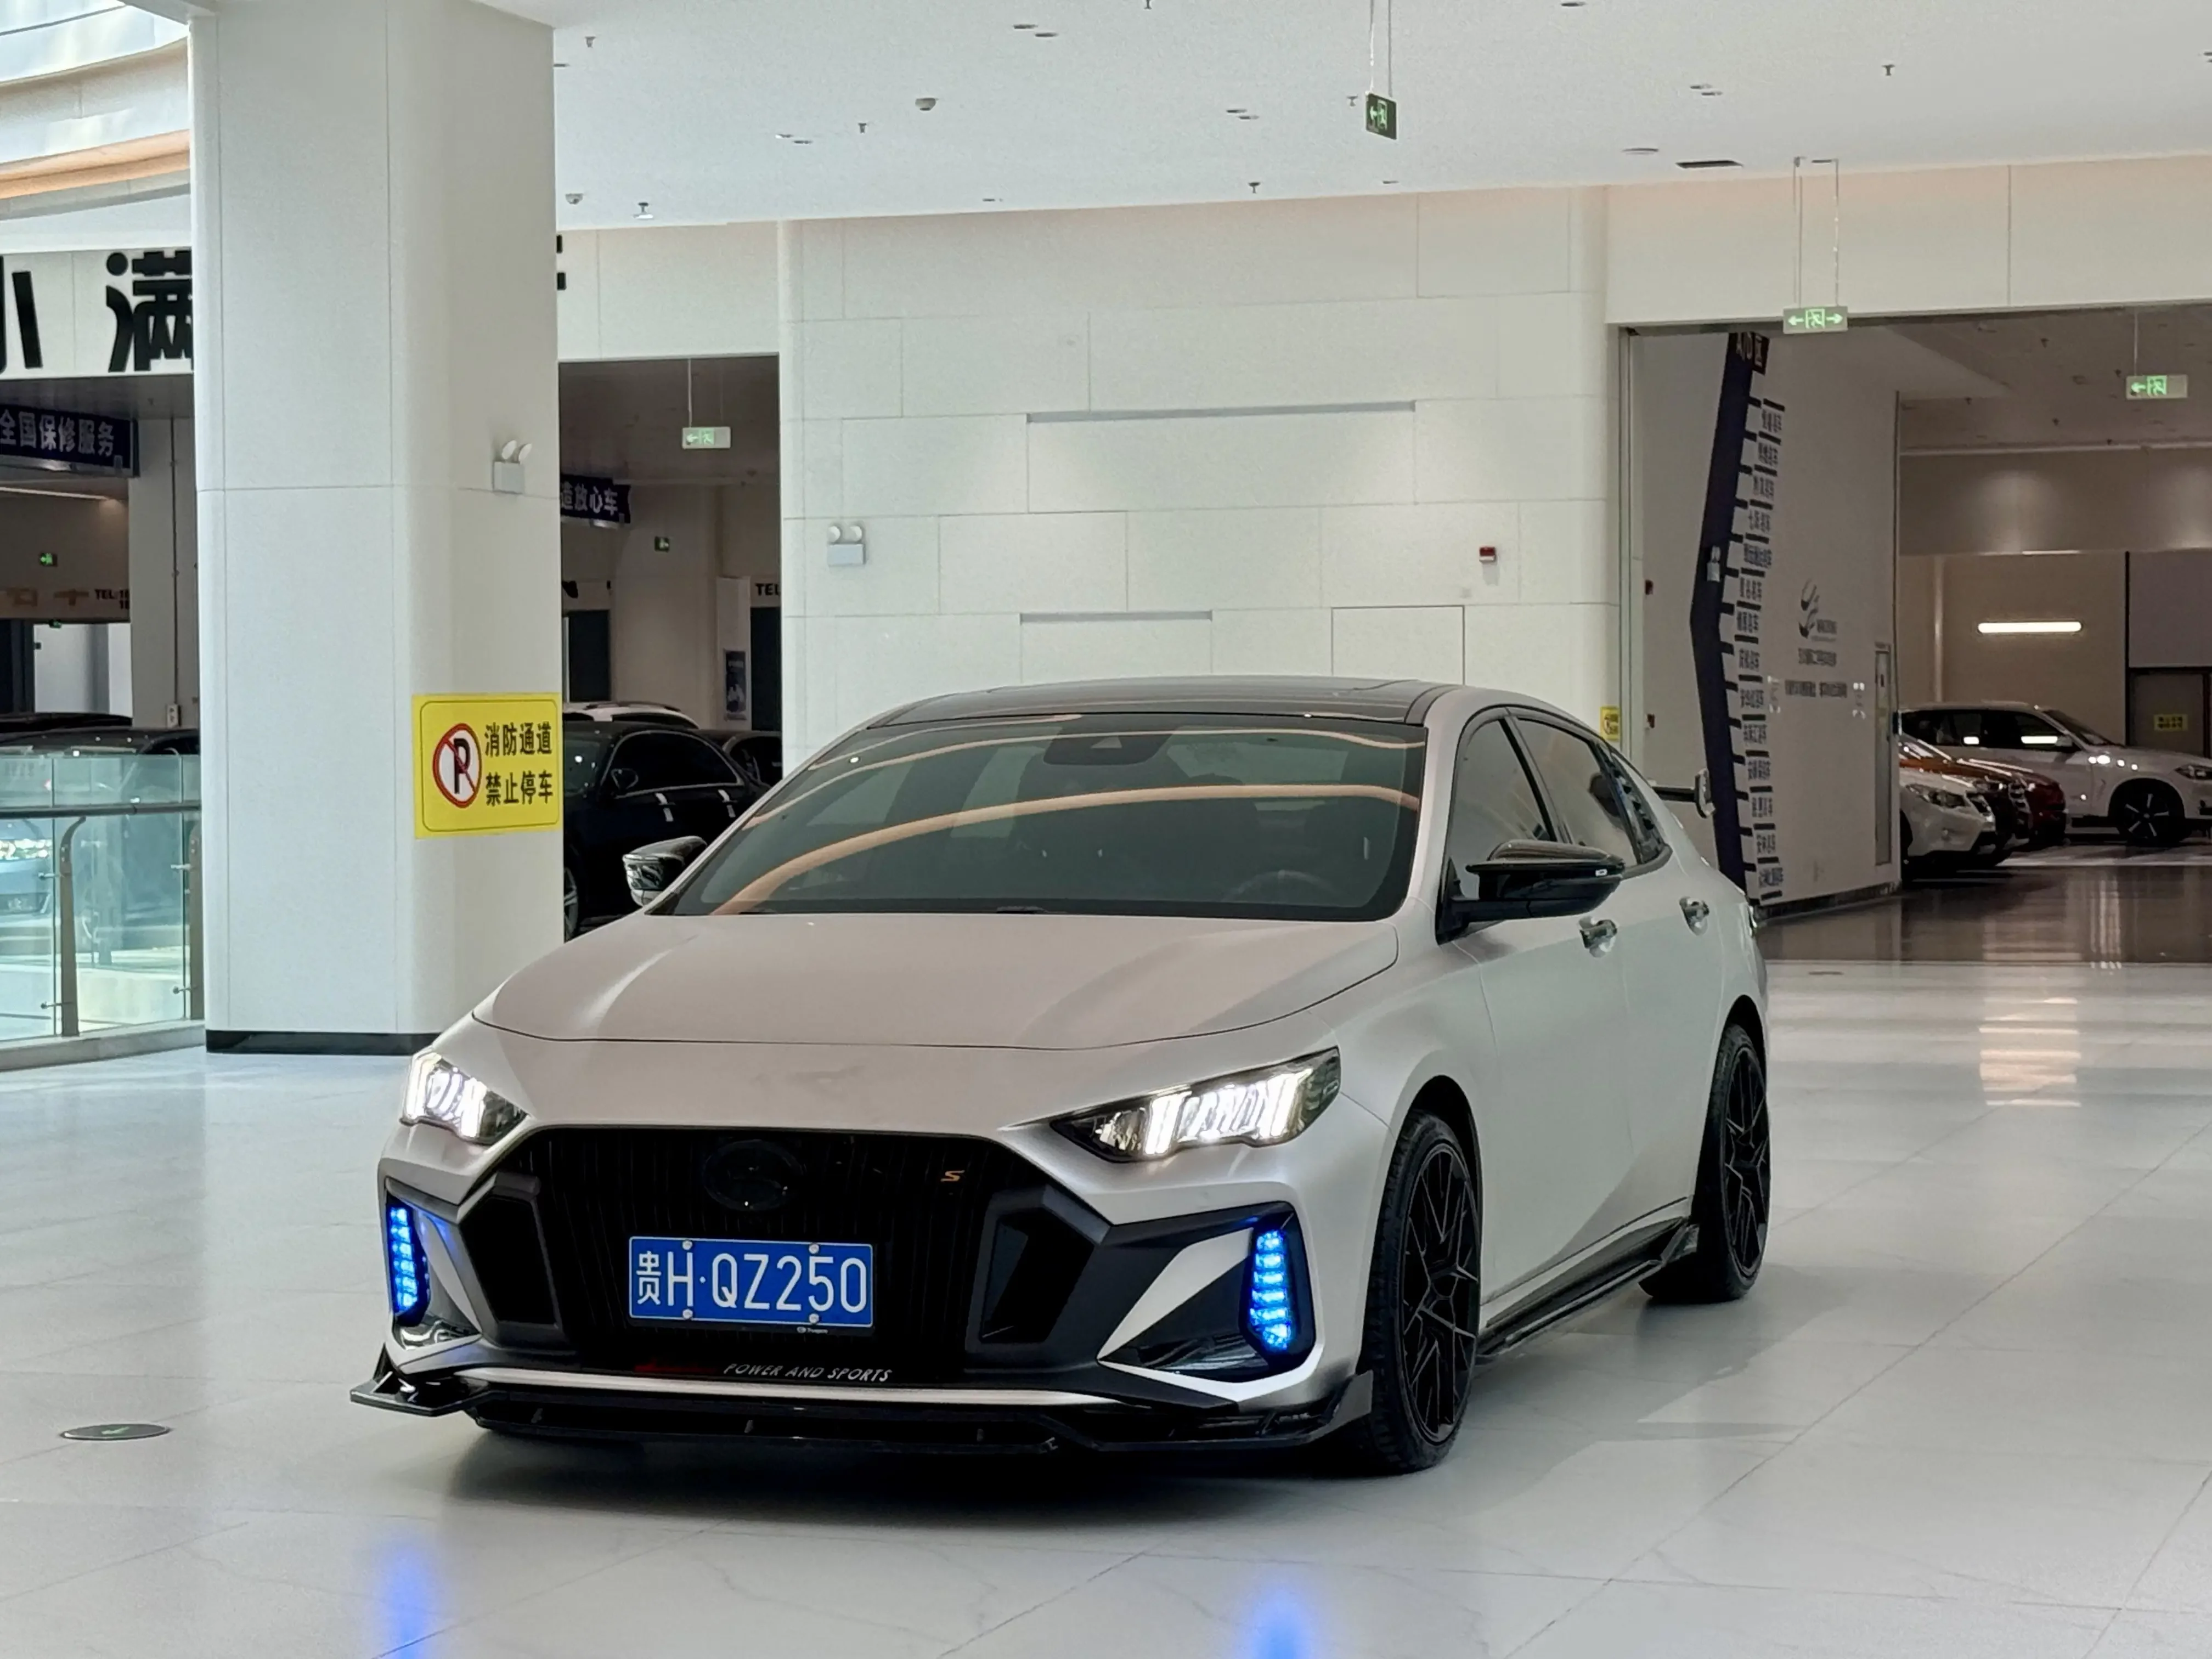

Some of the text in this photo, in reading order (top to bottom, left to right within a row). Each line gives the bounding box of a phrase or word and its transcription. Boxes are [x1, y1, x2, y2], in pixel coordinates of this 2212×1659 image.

[0, 409, 114, 457] 全国保修服务
[484, 721, 552, 757] 消防通道
[485, 770, 553, 806] 禁止停车
[940, 1170, 965, 1182] S
[636, 1250, 867, 1313] 贵H·QZ250
[723, 1363, 784, 1376] POWER
[785, 1366, 825, 1378] AND
[827, 1367, 893, 1382] SPORTS
